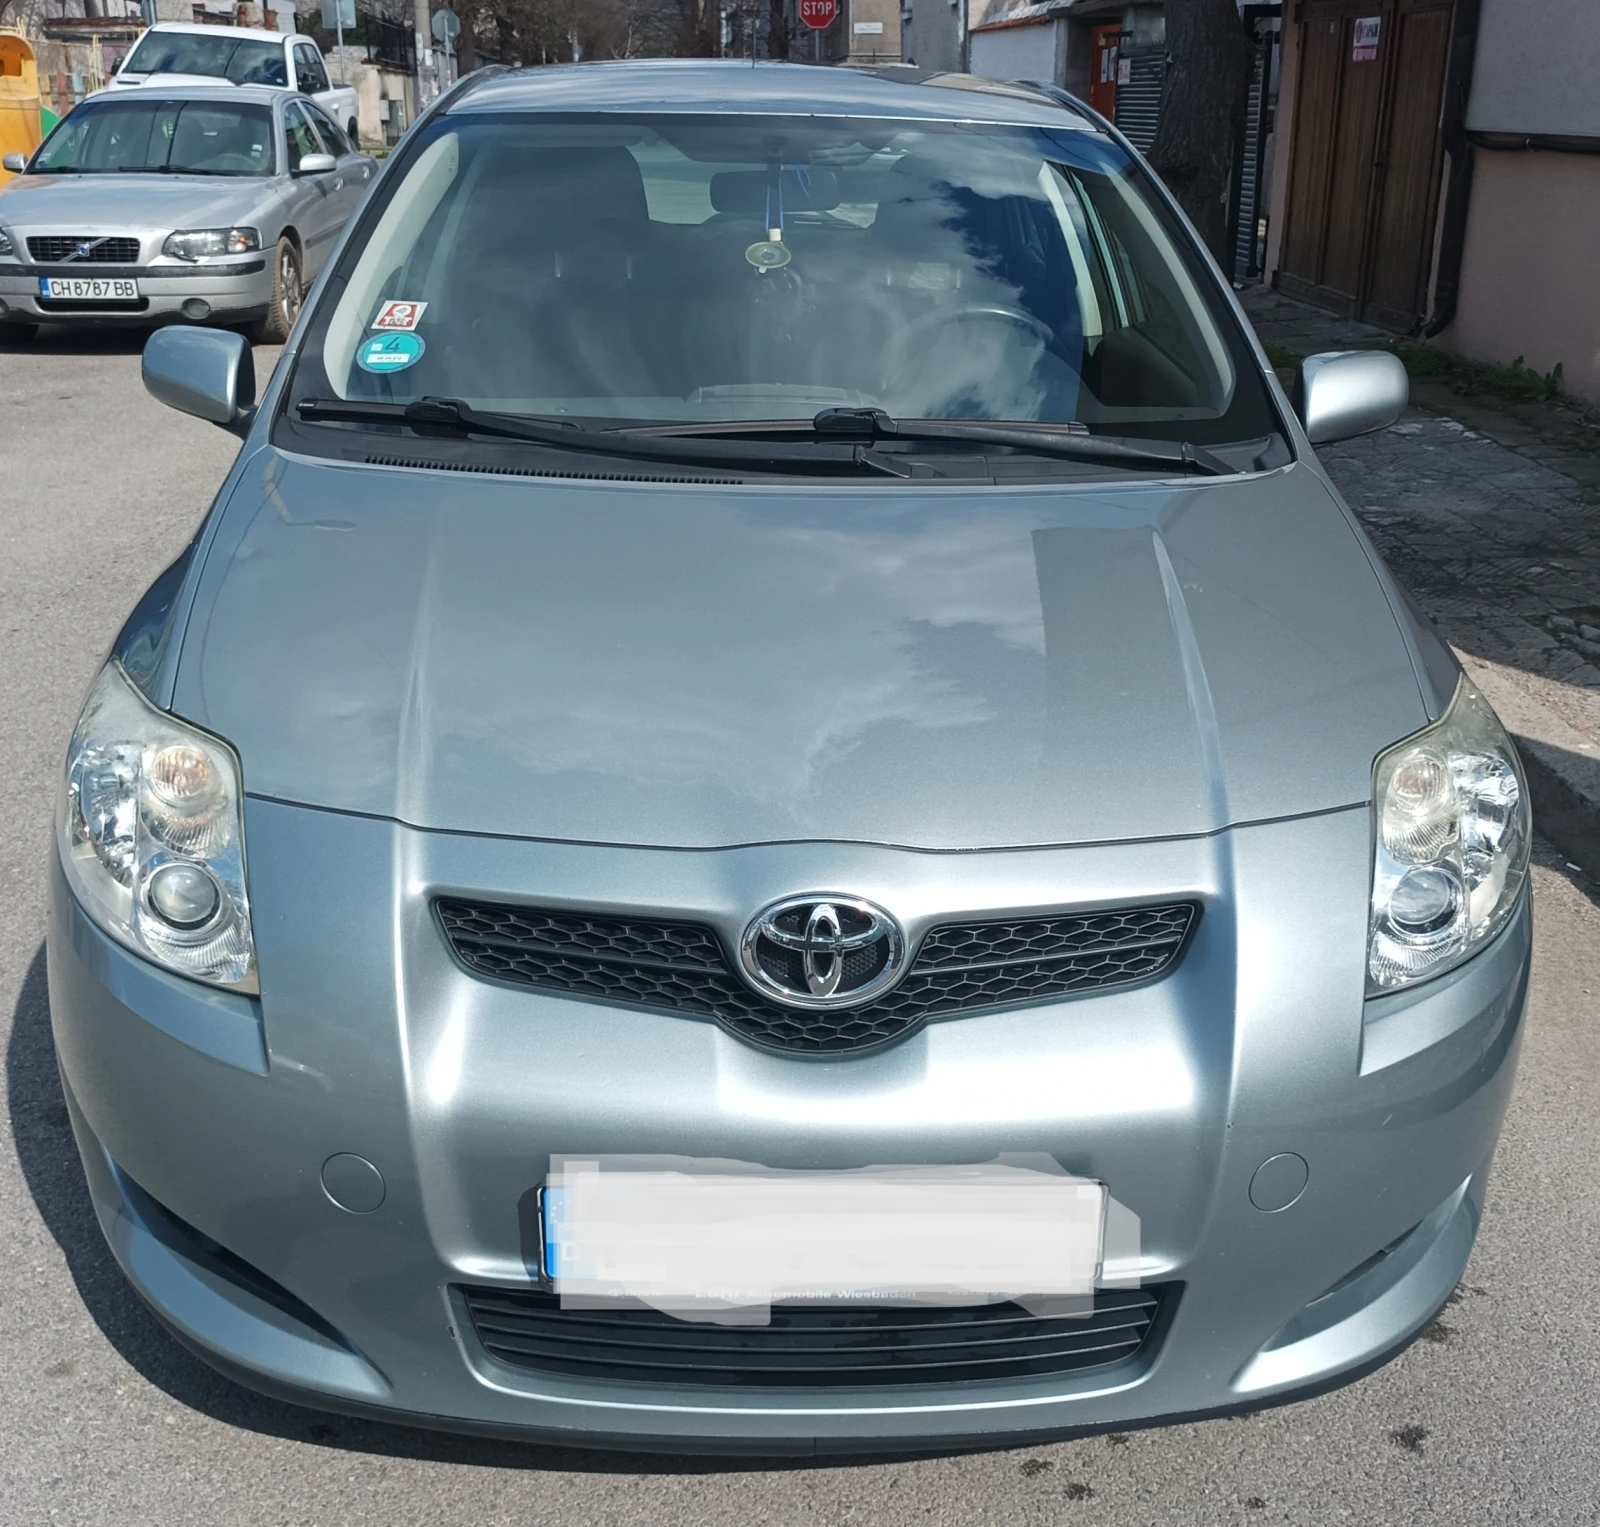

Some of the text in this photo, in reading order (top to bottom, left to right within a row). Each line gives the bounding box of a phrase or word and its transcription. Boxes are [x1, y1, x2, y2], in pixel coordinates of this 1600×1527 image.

[803, 2, 832, 16] STOP
[51, 281, 135, 296] CH 8787 BB
[384, 336, 400, 352] 4
[837, 1289, 917, 1299] Wiesbaden
